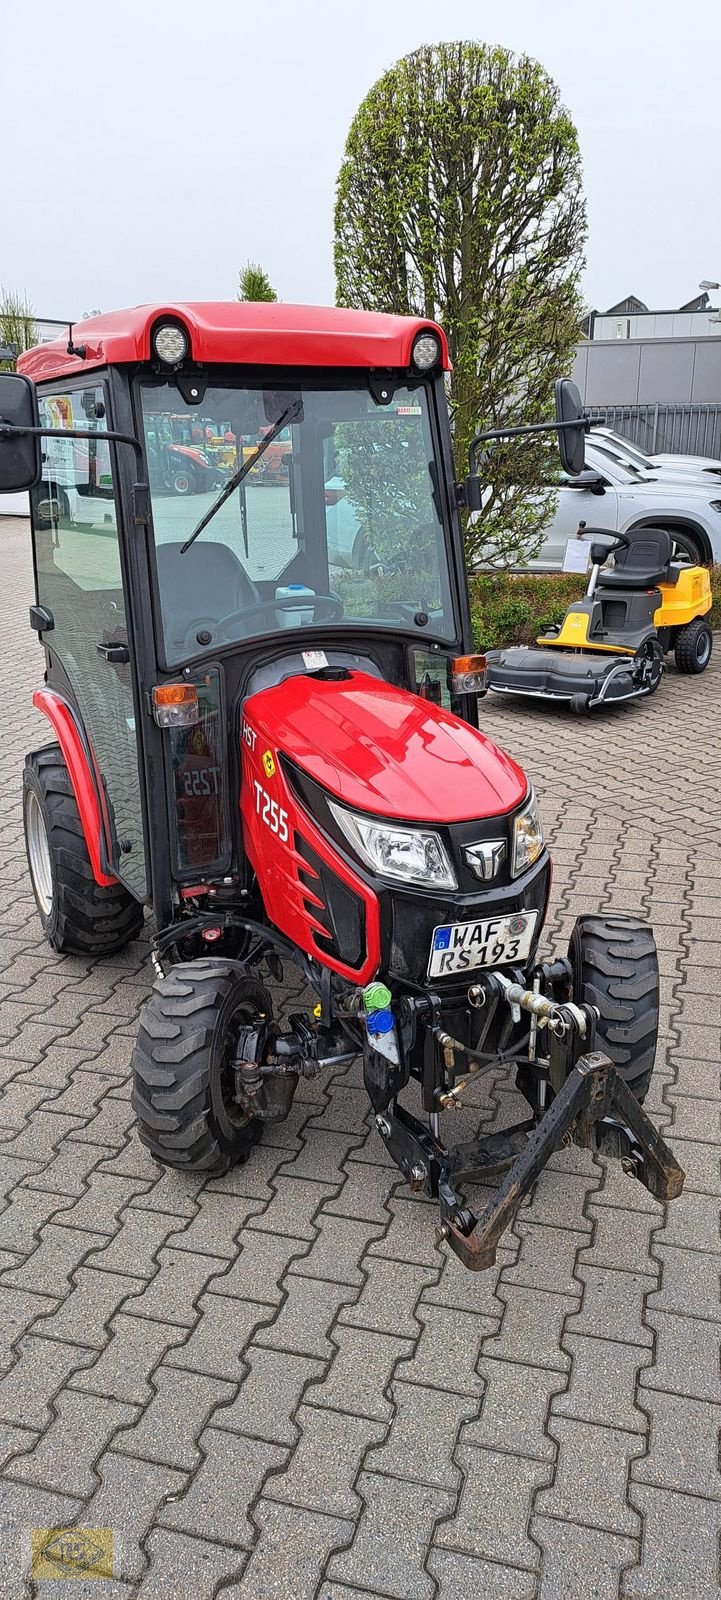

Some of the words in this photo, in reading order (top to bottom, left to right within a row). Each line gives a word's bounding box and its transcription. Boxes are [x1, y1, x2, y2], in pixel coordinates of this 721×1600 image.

[242, 720, 257, 752] HST
[254, 780, 288, 842] T255
[453, 921, 502, 949] WAF
[439, 939, 521, 973] RS193
